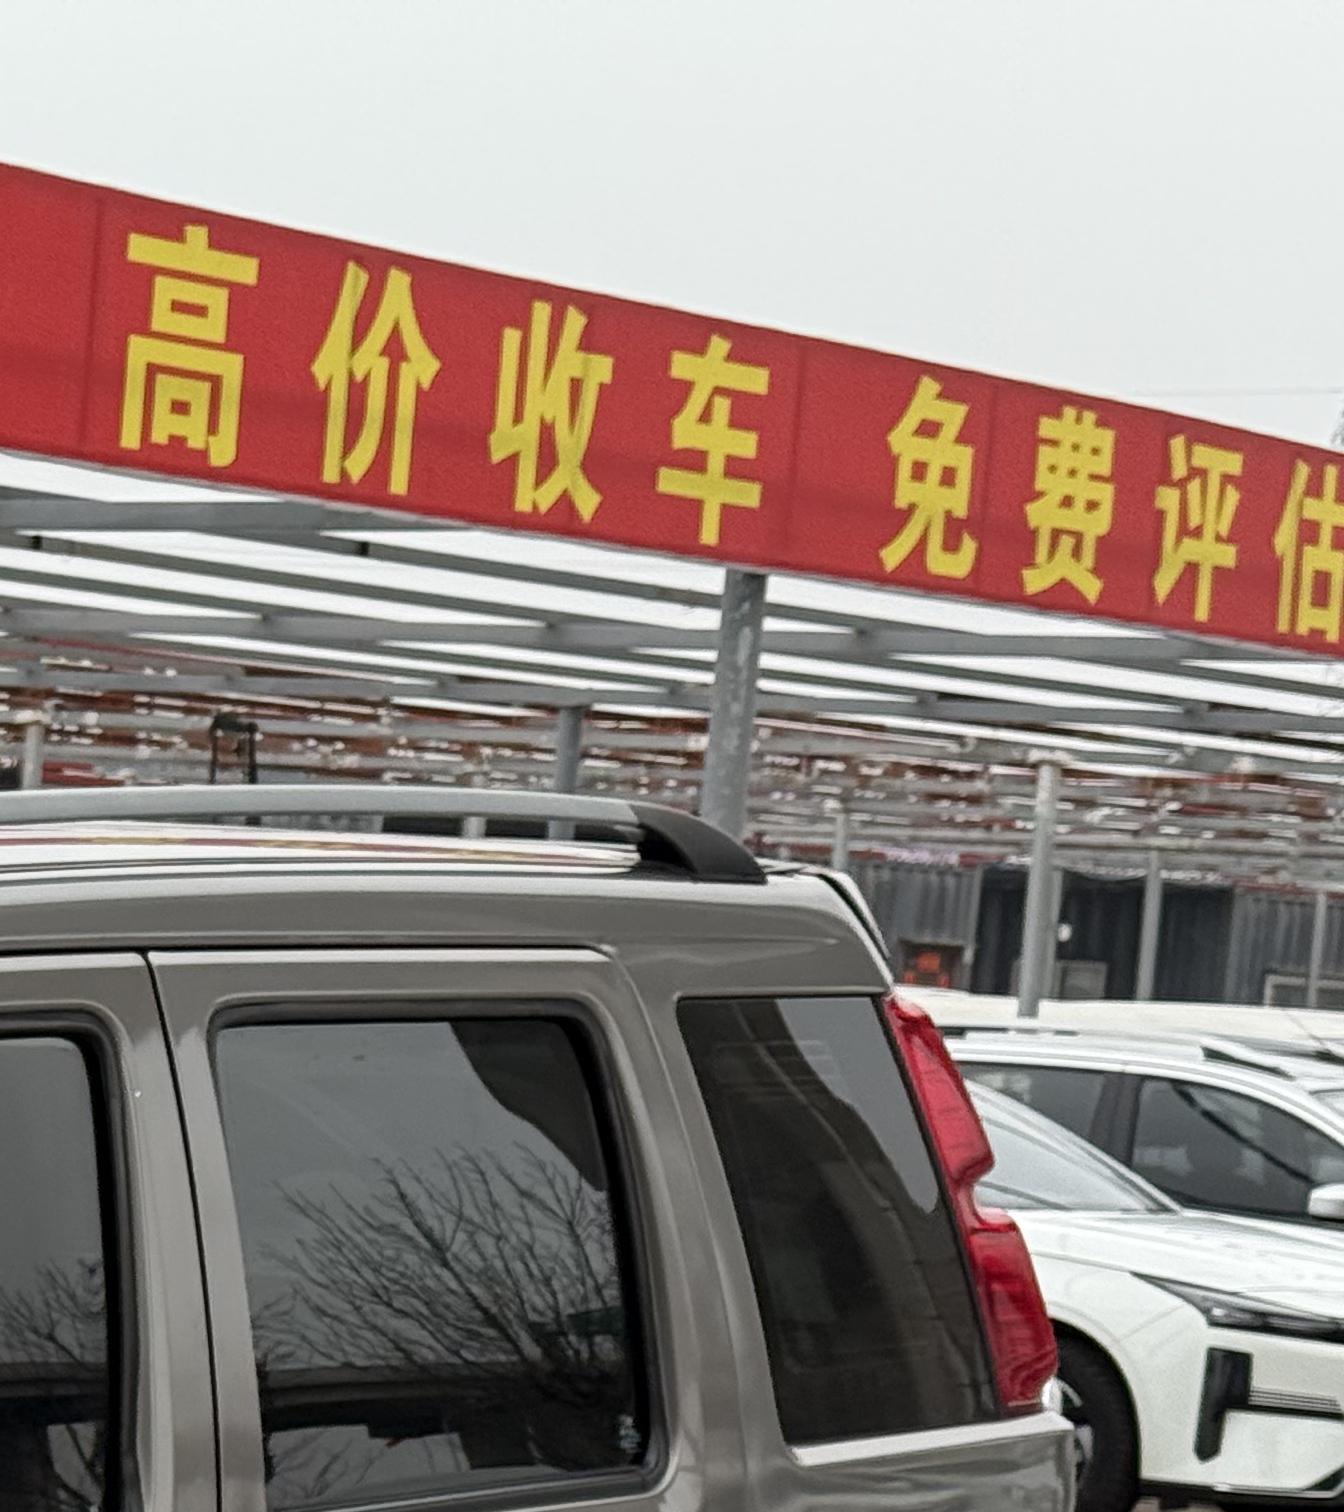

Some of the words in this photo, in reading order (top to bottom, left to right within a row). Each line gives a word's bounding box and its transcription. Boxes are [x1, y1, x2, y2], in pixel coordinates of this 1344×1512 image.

[118, 224, 771, 547] 高价收车
[878, 376, 1344, 644] 免费评估
